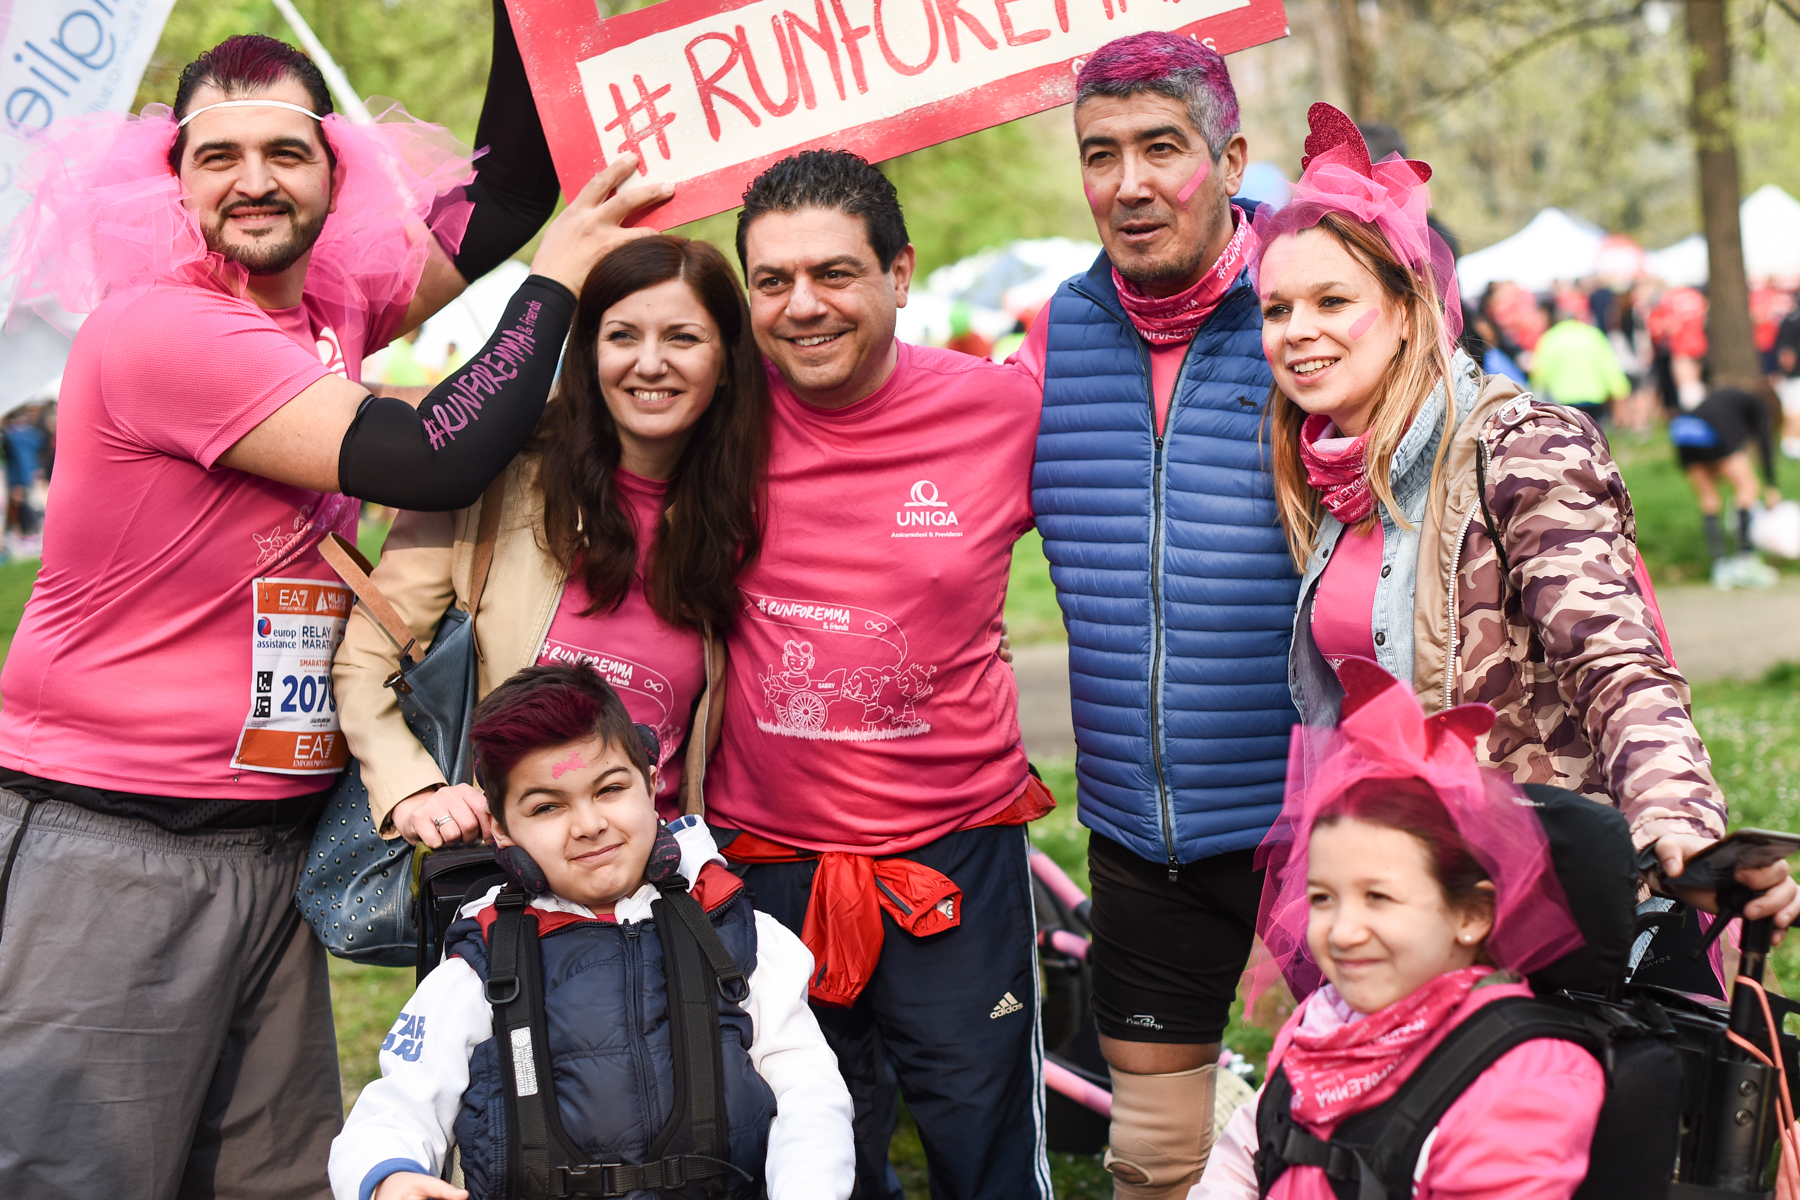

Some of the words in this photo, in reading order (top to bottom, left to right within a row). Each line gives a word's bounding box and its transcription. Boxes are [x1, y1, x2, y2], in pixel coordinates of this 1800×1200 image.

[604, 0, 1181, 177] #RUNFORE
[422, 329, 536, 450] #RUNFOREMMA
[519, 300, 543, 327] friends
[897, 511, 958, 526] UNIQA
[279, 589, 309, 607] EA7
[757, 598, 850, 623] #RUNFOREMMA
[273, 629, 297, 639] europ
[302, 626, 331, 638] RELAY
[830, 623, 849, 631] friends
[257, 639, 297, 649] assistance
[612, 676, 630, 686] friends
[294, 734, 335, 759] EA7
[1640, 955, 1670, 969] OMYOS
[990, 1003, 1023, 1019] adidas
